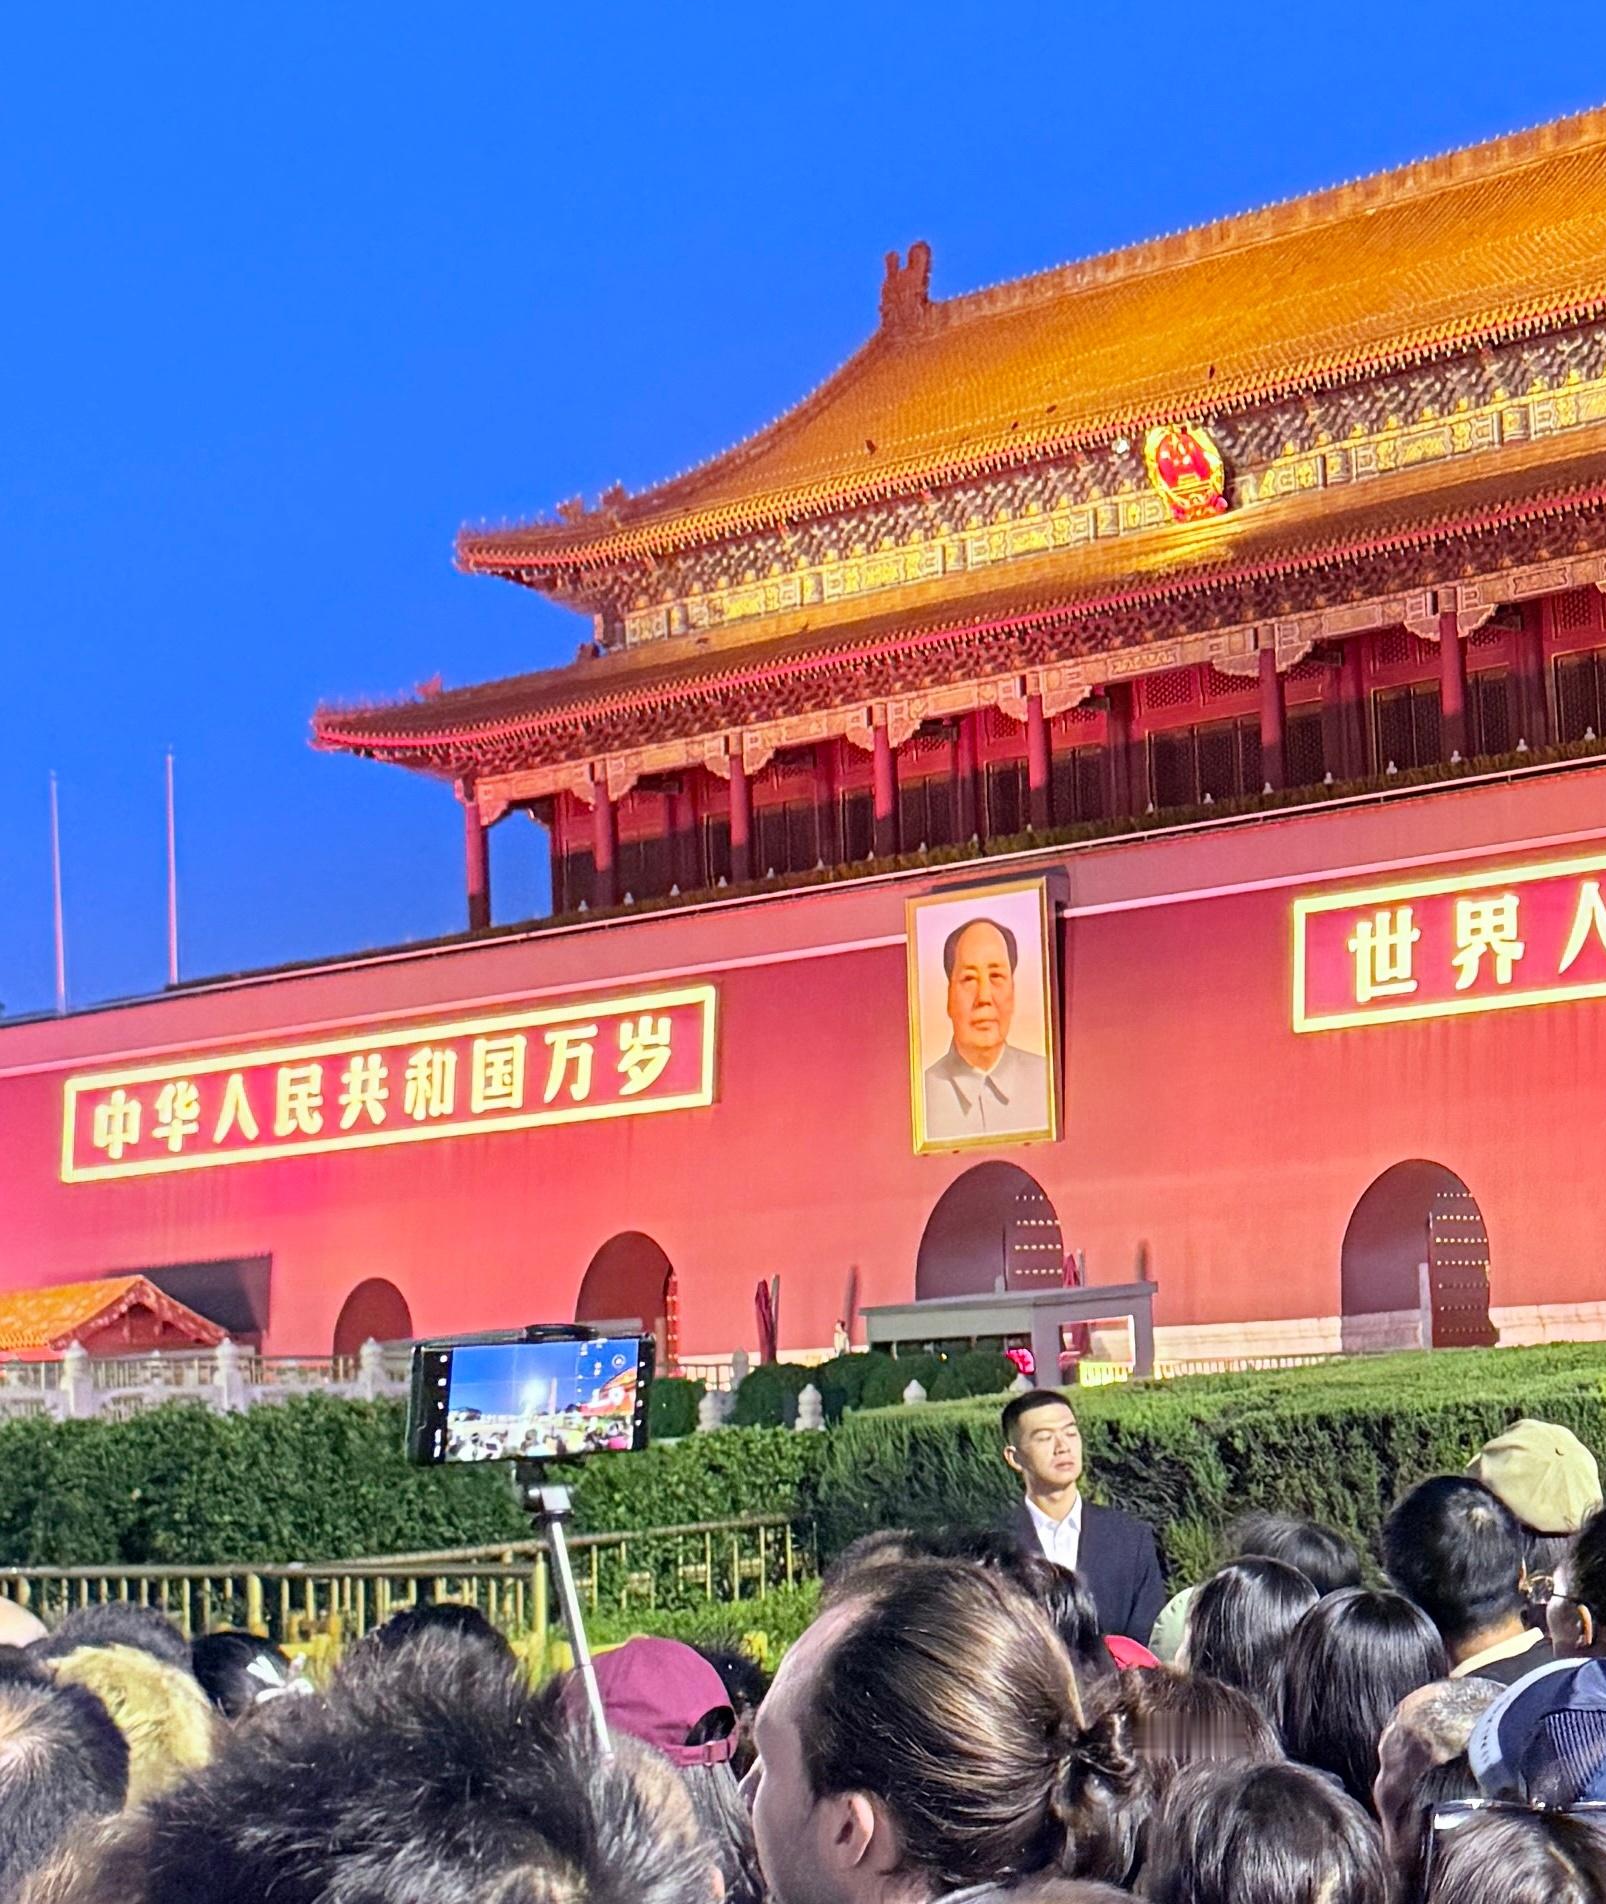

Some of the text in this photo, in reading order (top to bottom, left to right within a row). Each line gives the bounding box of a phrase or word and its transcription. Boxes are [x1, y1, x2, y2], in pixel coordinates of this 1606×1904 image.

[92, 1014, 674, 1160] 中华人民共和国万岁
